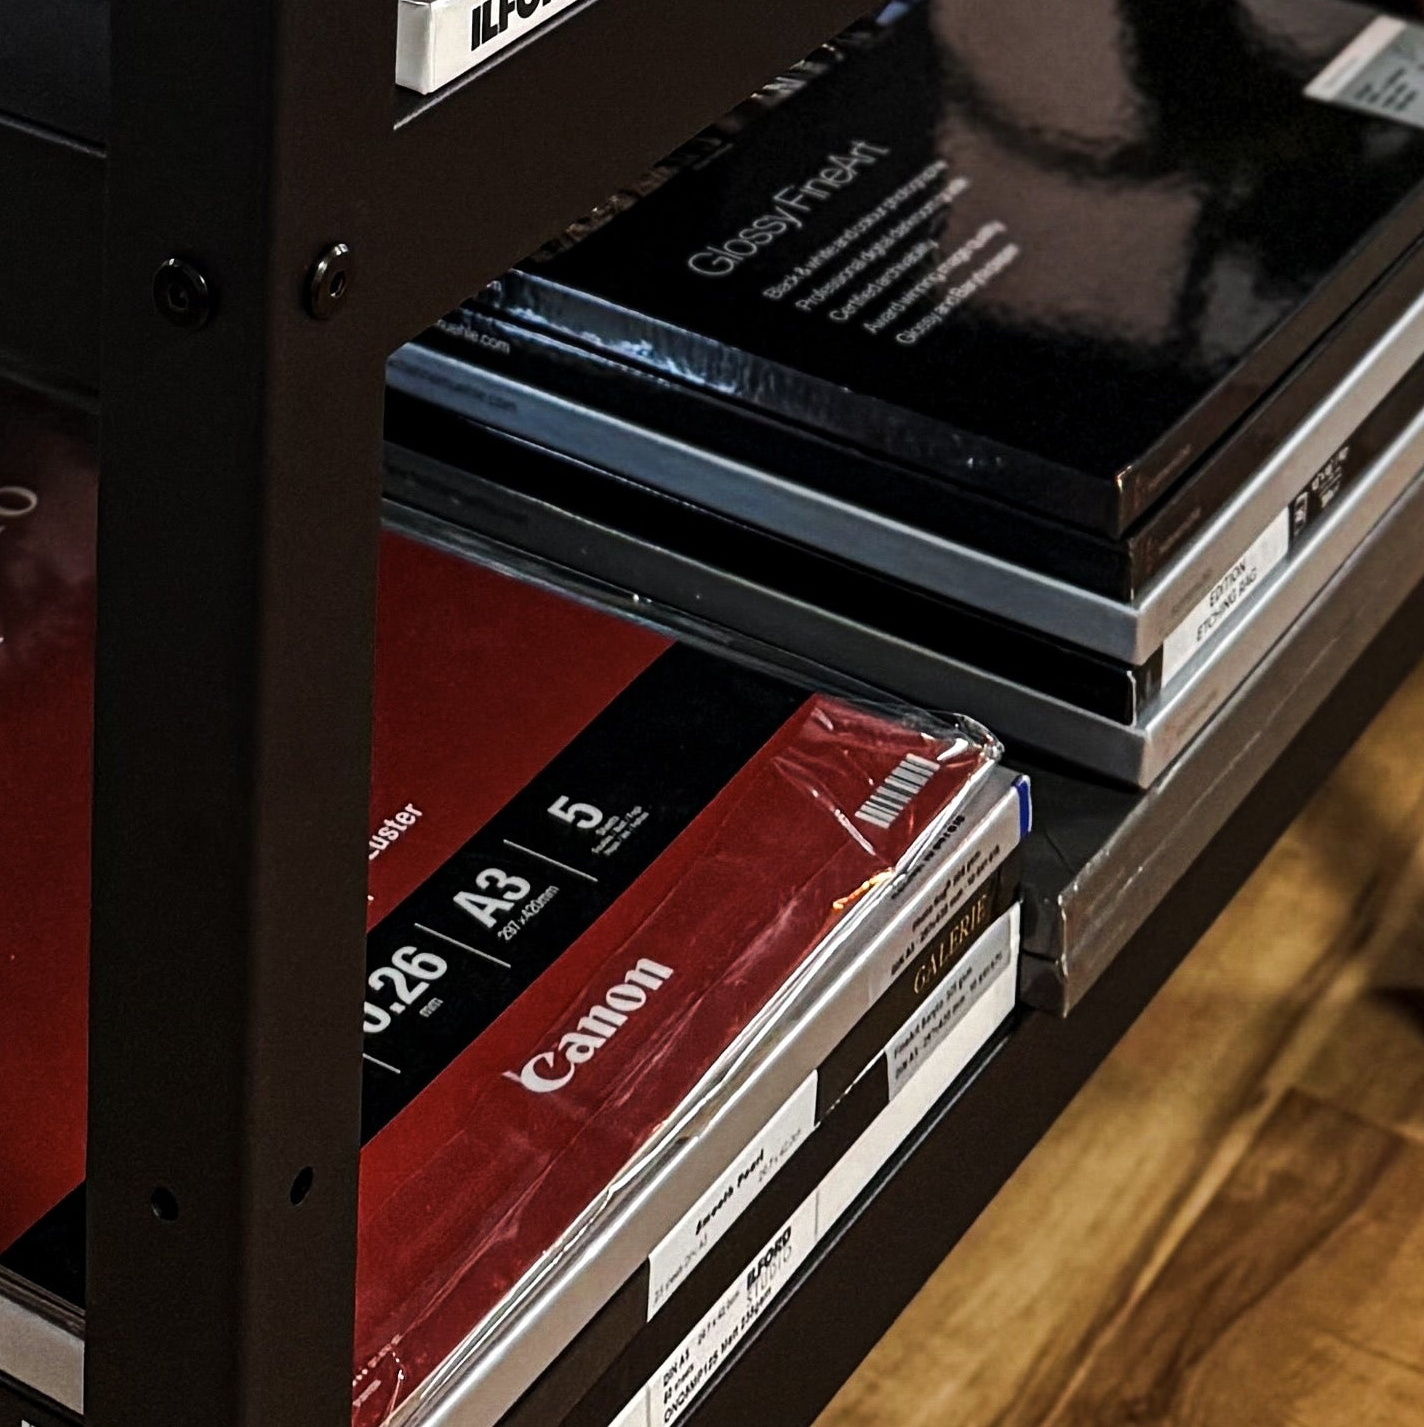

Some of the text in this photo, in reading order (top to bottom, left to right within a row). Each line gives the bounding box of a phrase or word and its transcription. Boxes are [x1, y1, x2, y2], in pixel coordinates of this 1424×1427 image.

[687, 139, 890, 278] GlossyFineArt
[762, 273, 803, 301] Black
[795, 257, 868, 312] Professional
[828, 281, 881, 323] Certified
[863, 302, 908, 334] Award
[895, 312, 942, 346] Glossy
[1210, 558, 1246, 607] EDITION
[547, 795, 604, 830] 5
[453, 868, 531, 929] A3
[914, 894, 988, 994] GALERIE
[517, 958, 675, 1095] Canon
[696, 1148, 765, 1236] Smooth Pearl
[746, 1245, 792, 1303] STUDIO
[747, 1226, 792, 1290] ILFORD
